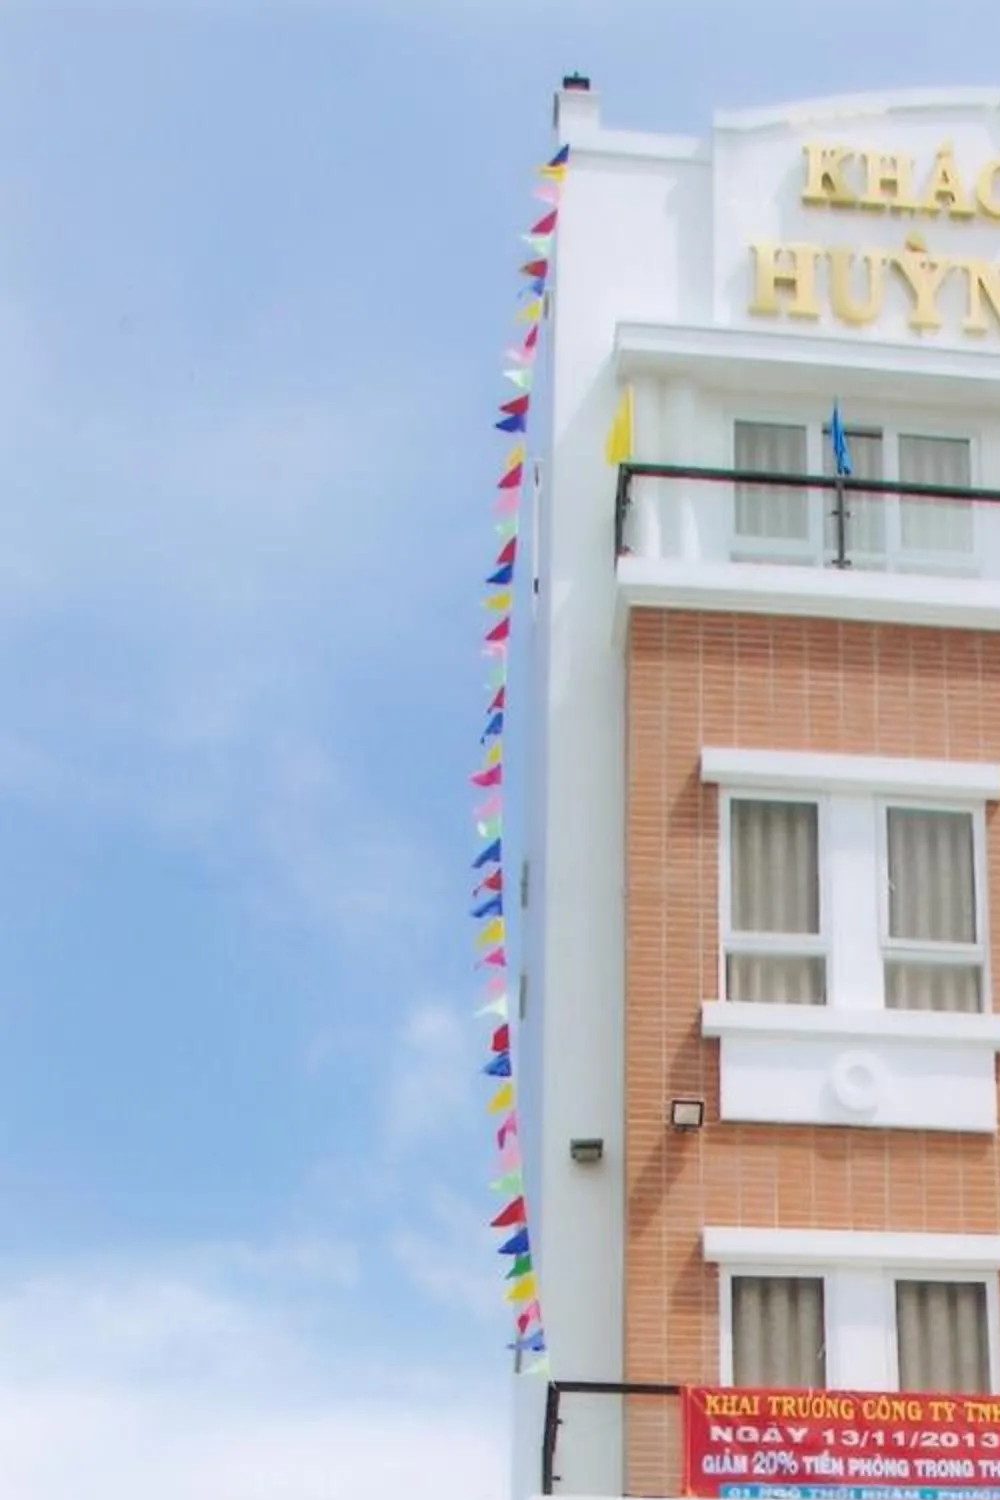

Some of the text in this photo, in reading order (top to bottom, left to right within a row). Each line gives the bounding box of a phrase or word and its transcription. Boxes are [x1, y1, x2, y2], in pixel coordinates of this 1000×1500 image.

[706, 1394, 760, 1416] KHAI
[863, 1395, 922, 1421] CÔNG
[929, 1401, 957, 1422] TY
[710, 1422, 808, 1443] NGÀY
[822, 1429, 1000, 1448] 13/11/2013
[752, 1450, 798, 1475] 20%
[914, 1458, 974, 1478] TRONG
